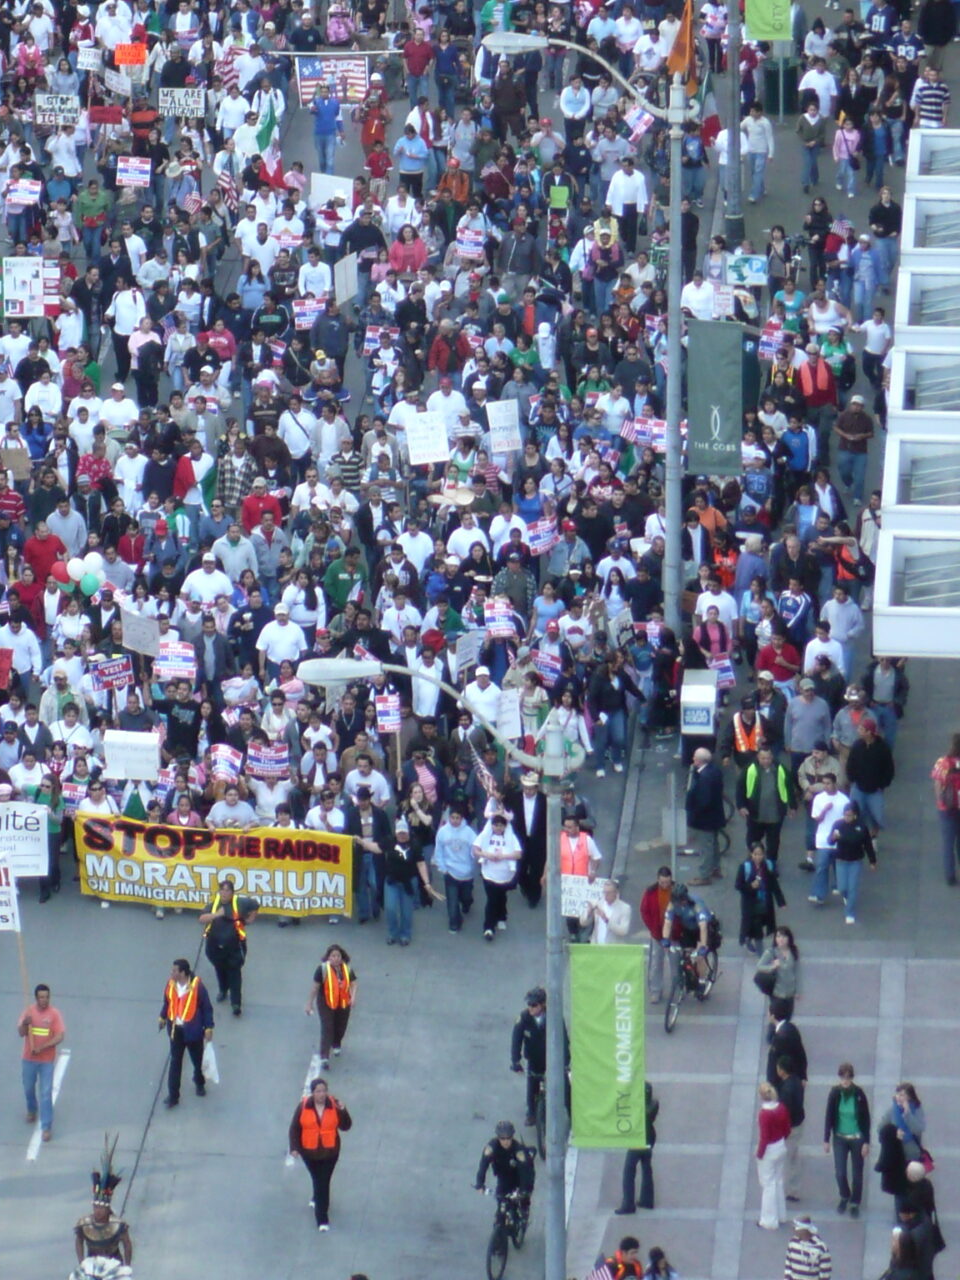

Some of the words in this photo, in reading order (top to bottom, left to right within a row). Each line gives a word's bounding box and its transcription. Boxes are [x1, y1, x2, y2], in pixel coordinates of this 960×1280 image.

[772, 3, 784, 33] CITY
[871, 14, 886, 32] 81
[897, 44, 916, 61] 83
[161, 90, 175, 98] WE
[184, 89, 202, 99] ARE
[169, 97, 191, 107] ALL
[751, 259, 762, 273] P
[746, 341, 754, 352] P
[694, 441, 709, 450] THE
[104, 663, 123, 675] YES!
[112, 675, 129, 686] NO!
[82, 818, 215, 860] STOP
[215, 833, 261, 858] THE
[263, 836, 340, 865] RAIDS!
[85, 853, 346, 897] MORATORIUM
[87, 879, 110, 894] ON
[114, 880, 209, 904] IMMIGRANT
[615, 981, 632, 1083] MOMENTS
[615, 1090, 632, 1134] CITY
